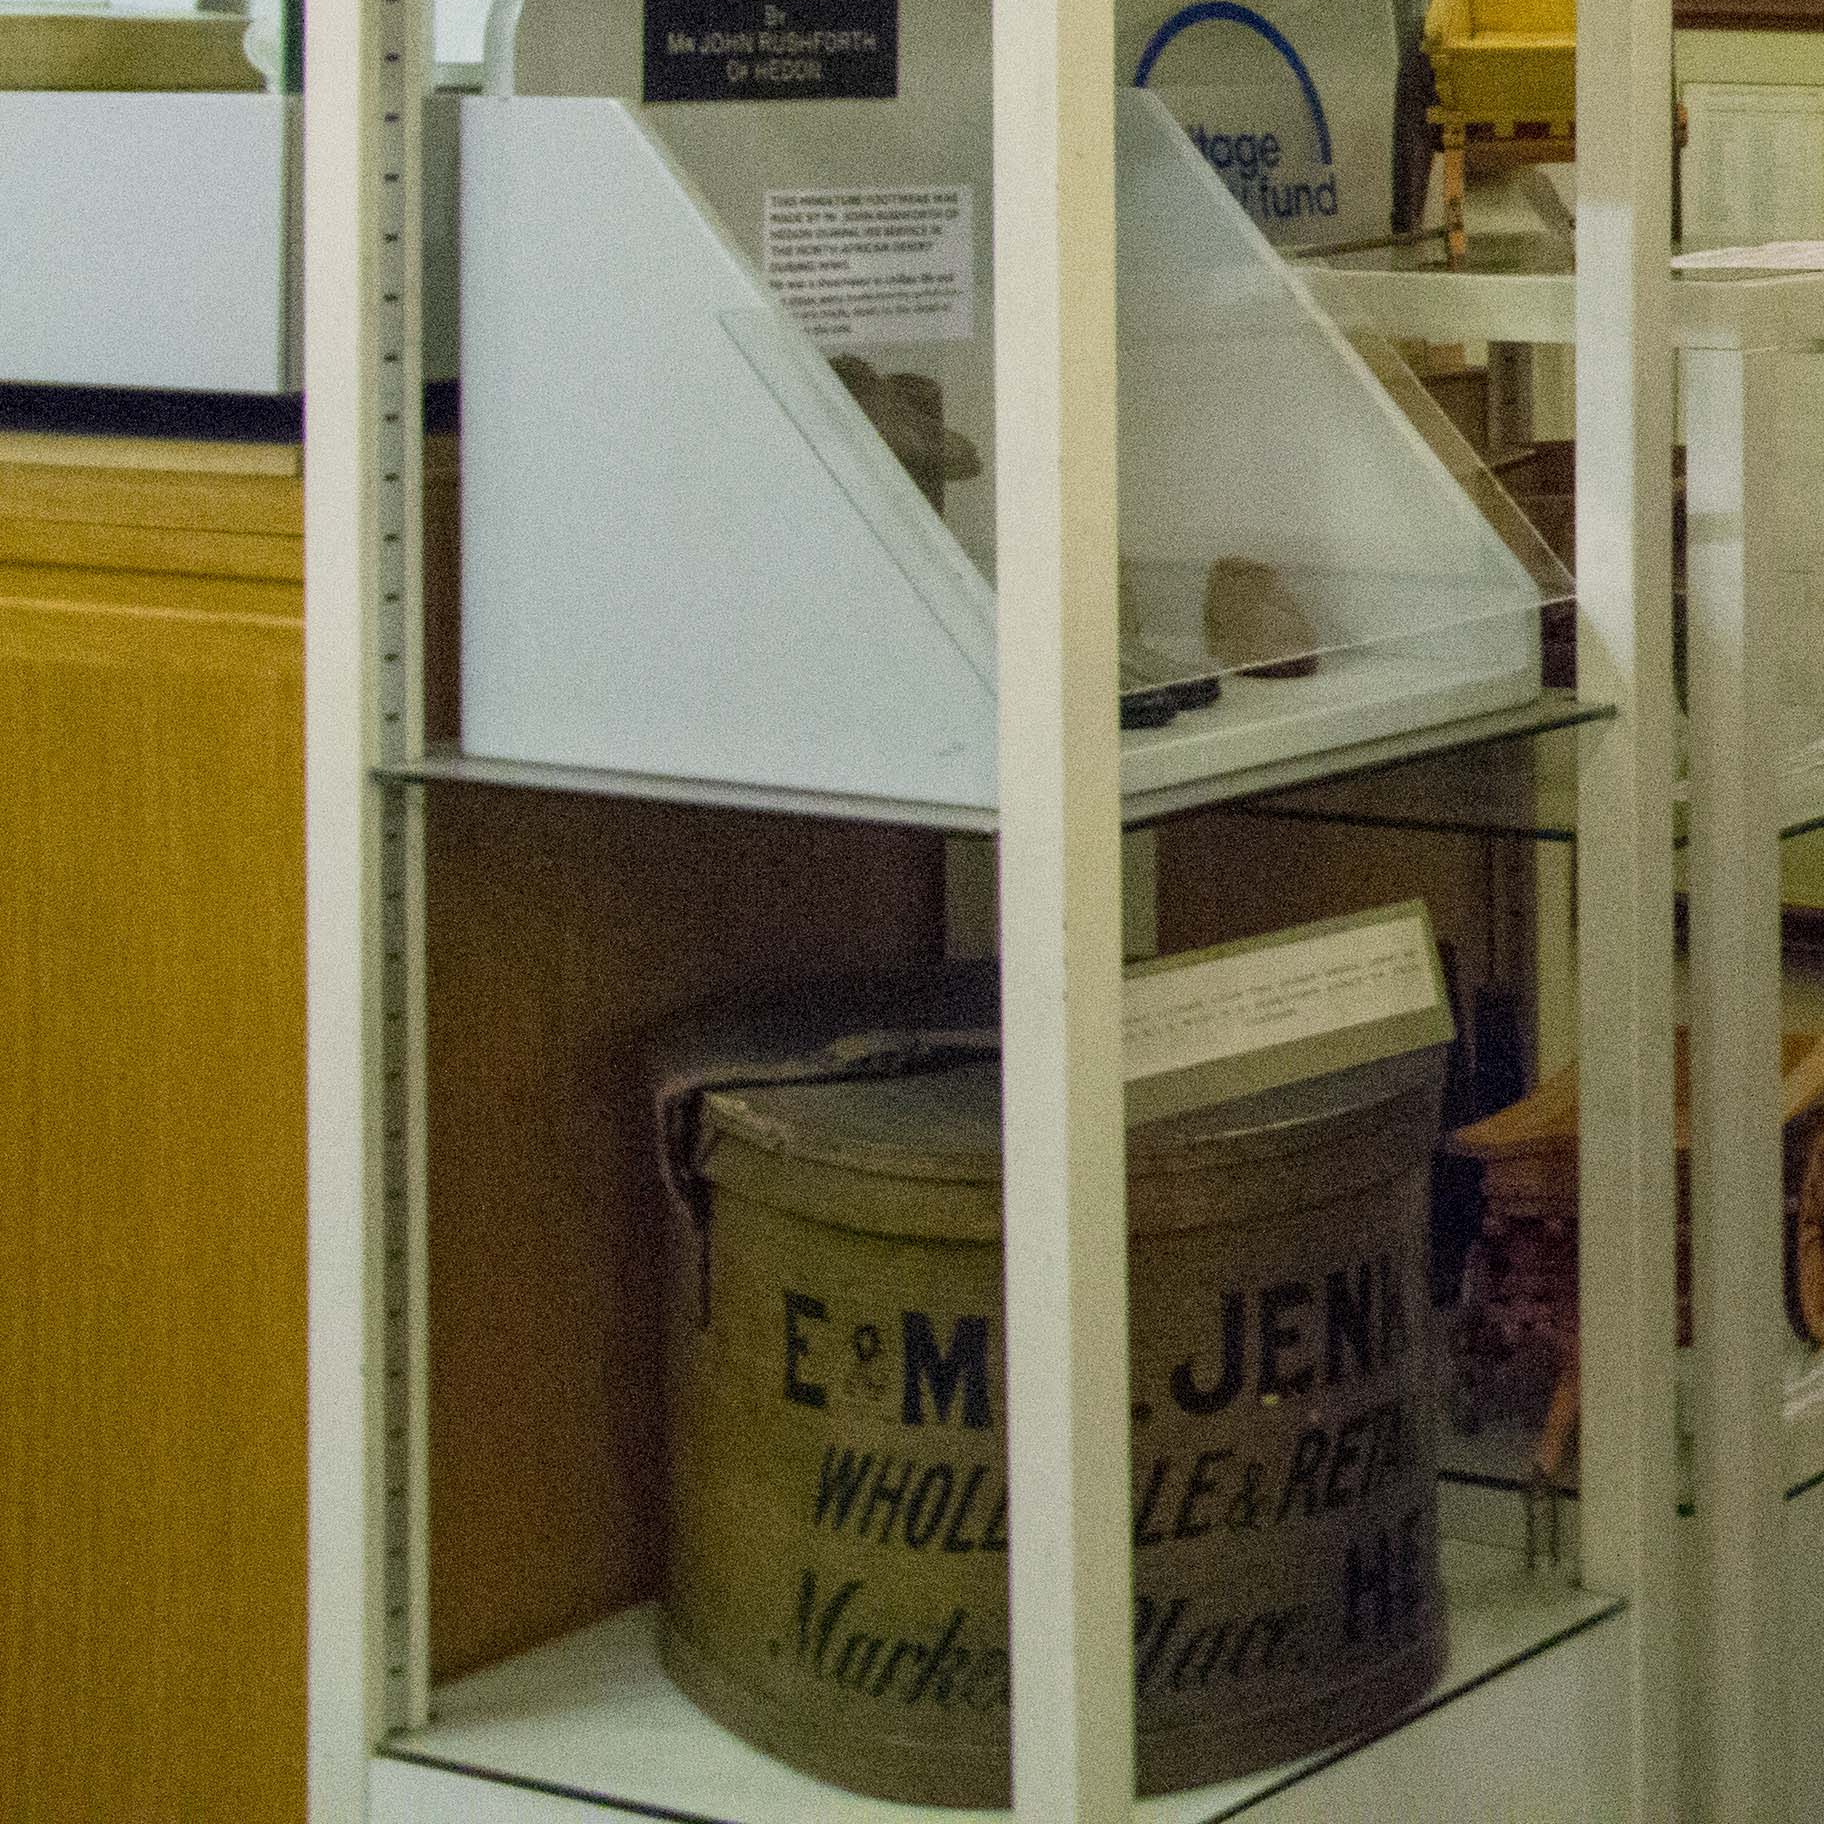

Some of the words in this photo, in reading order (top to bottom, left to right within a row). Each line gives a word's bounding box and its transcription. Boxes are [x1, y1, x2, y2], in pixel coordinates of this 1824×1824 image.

[699, 30, 755, 55] JOHN
[758, 29, 877, 55] RUSHFORTH
[783, 1288, 829, 1410] E
